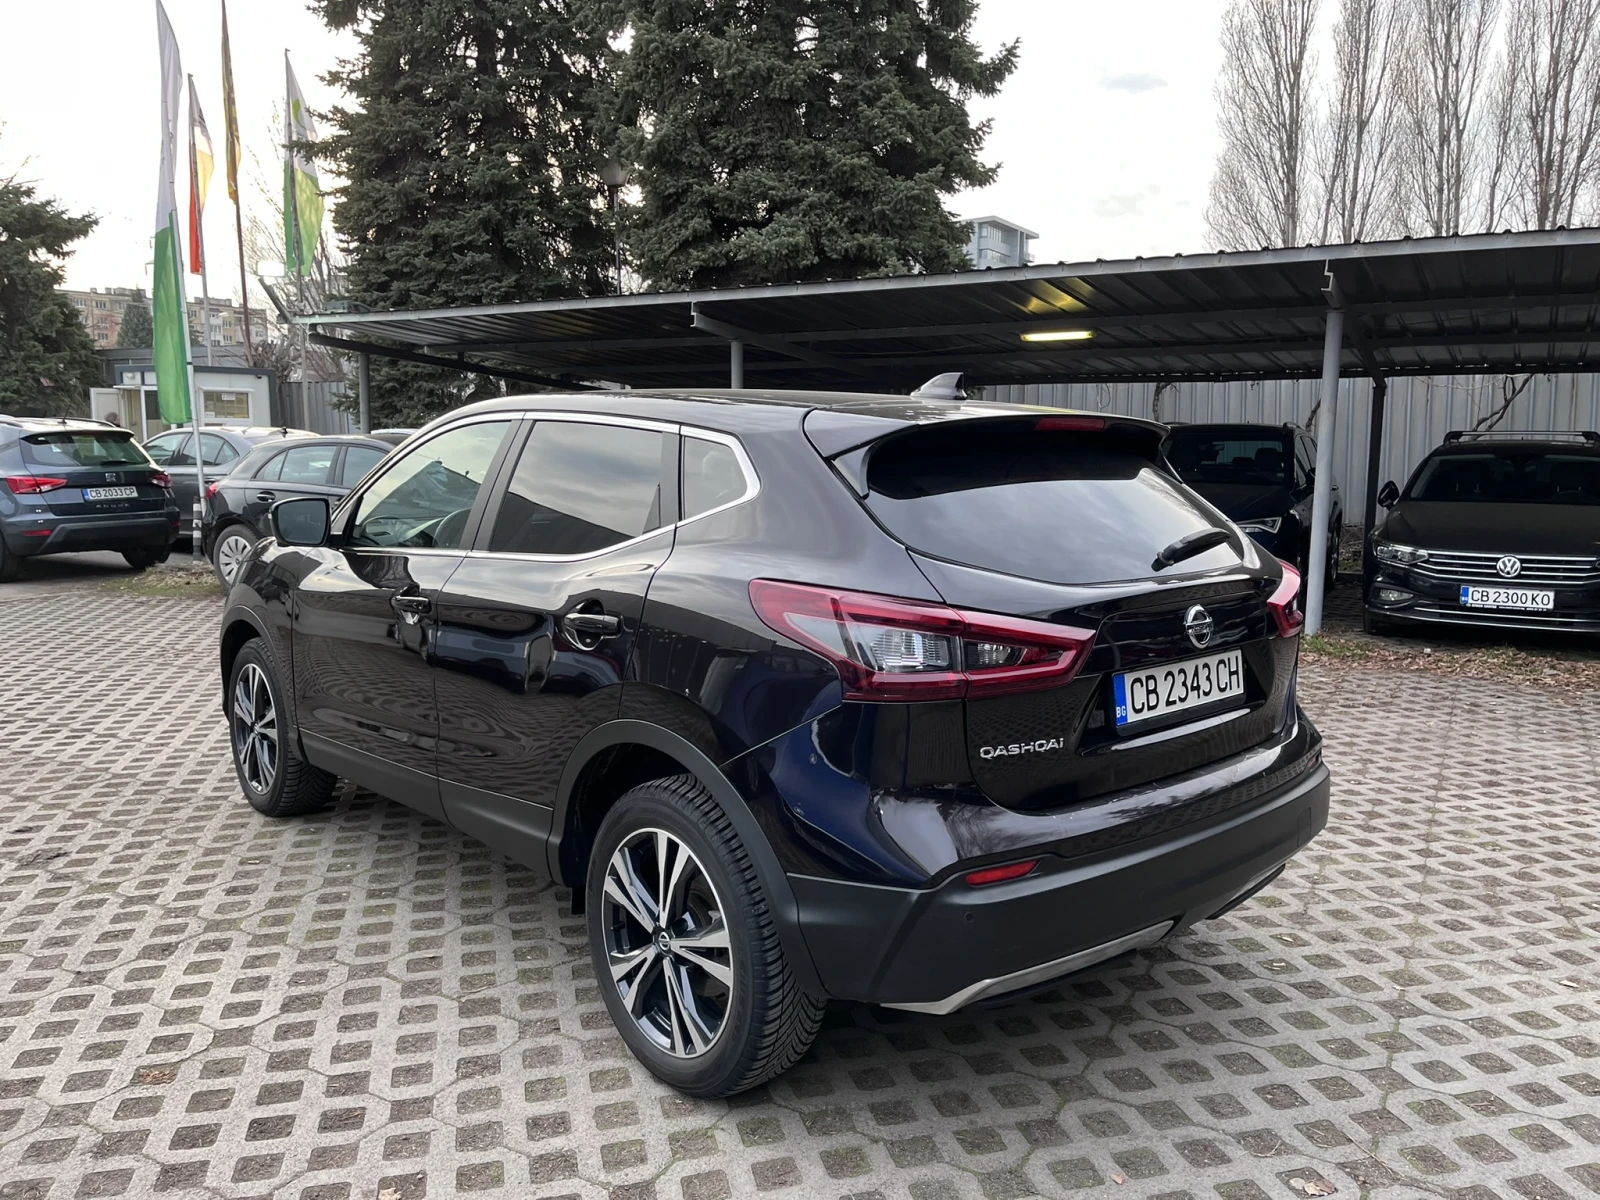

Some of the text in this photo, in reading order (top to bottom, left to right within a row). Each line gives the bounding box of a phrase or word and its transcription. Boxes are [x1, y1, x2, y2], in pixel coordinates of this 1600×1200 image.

[90, 489, 101, 498] CB
[102, 488, 124, 497] 2033
[1471, 589, 1489, 602] CB
[1492, 591, 1528, 605] 2300
[1130, 655, 1240, 714] CB 2343 CH
[1116, 705, 1126, 718] BG
[980, 738, 1064, 759] QASHQAI
